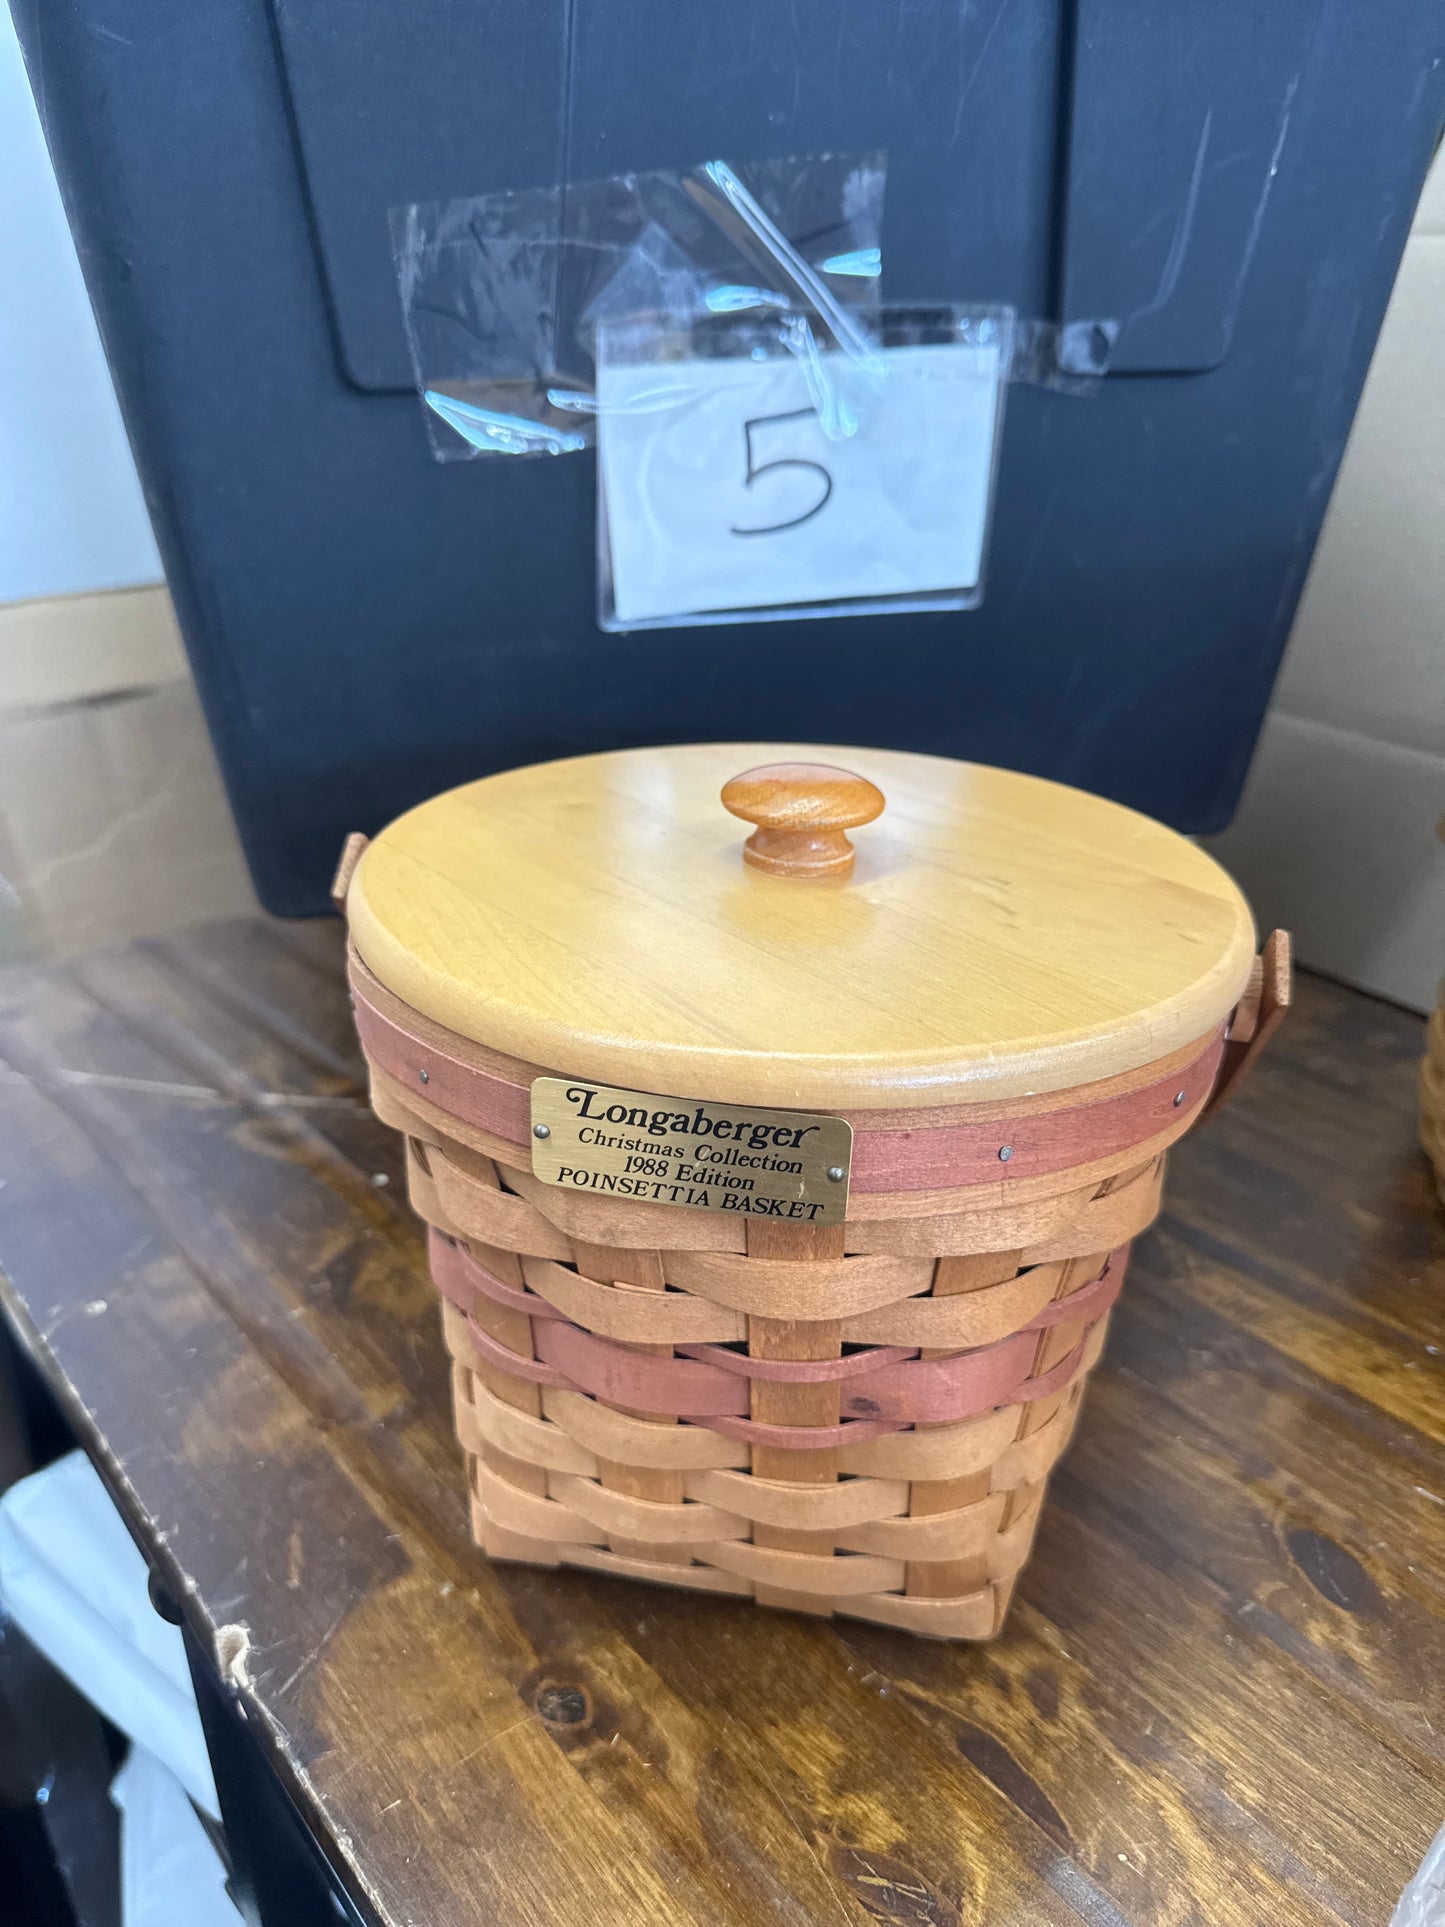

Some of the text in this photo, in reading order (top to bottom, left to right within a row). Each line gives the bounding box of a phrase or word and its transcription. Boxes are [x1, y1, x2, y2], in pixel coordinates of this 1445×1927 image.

[730, 407, 833, 535] 5
[565, 1087, 821, 1150] Longaberger
[578, 1127, 803, 1174] Christmas Collection
[624, 1155, 756, 1191] 1988 Edition
[557, 1167, 824, 1221] POINSETTIA BASKET
